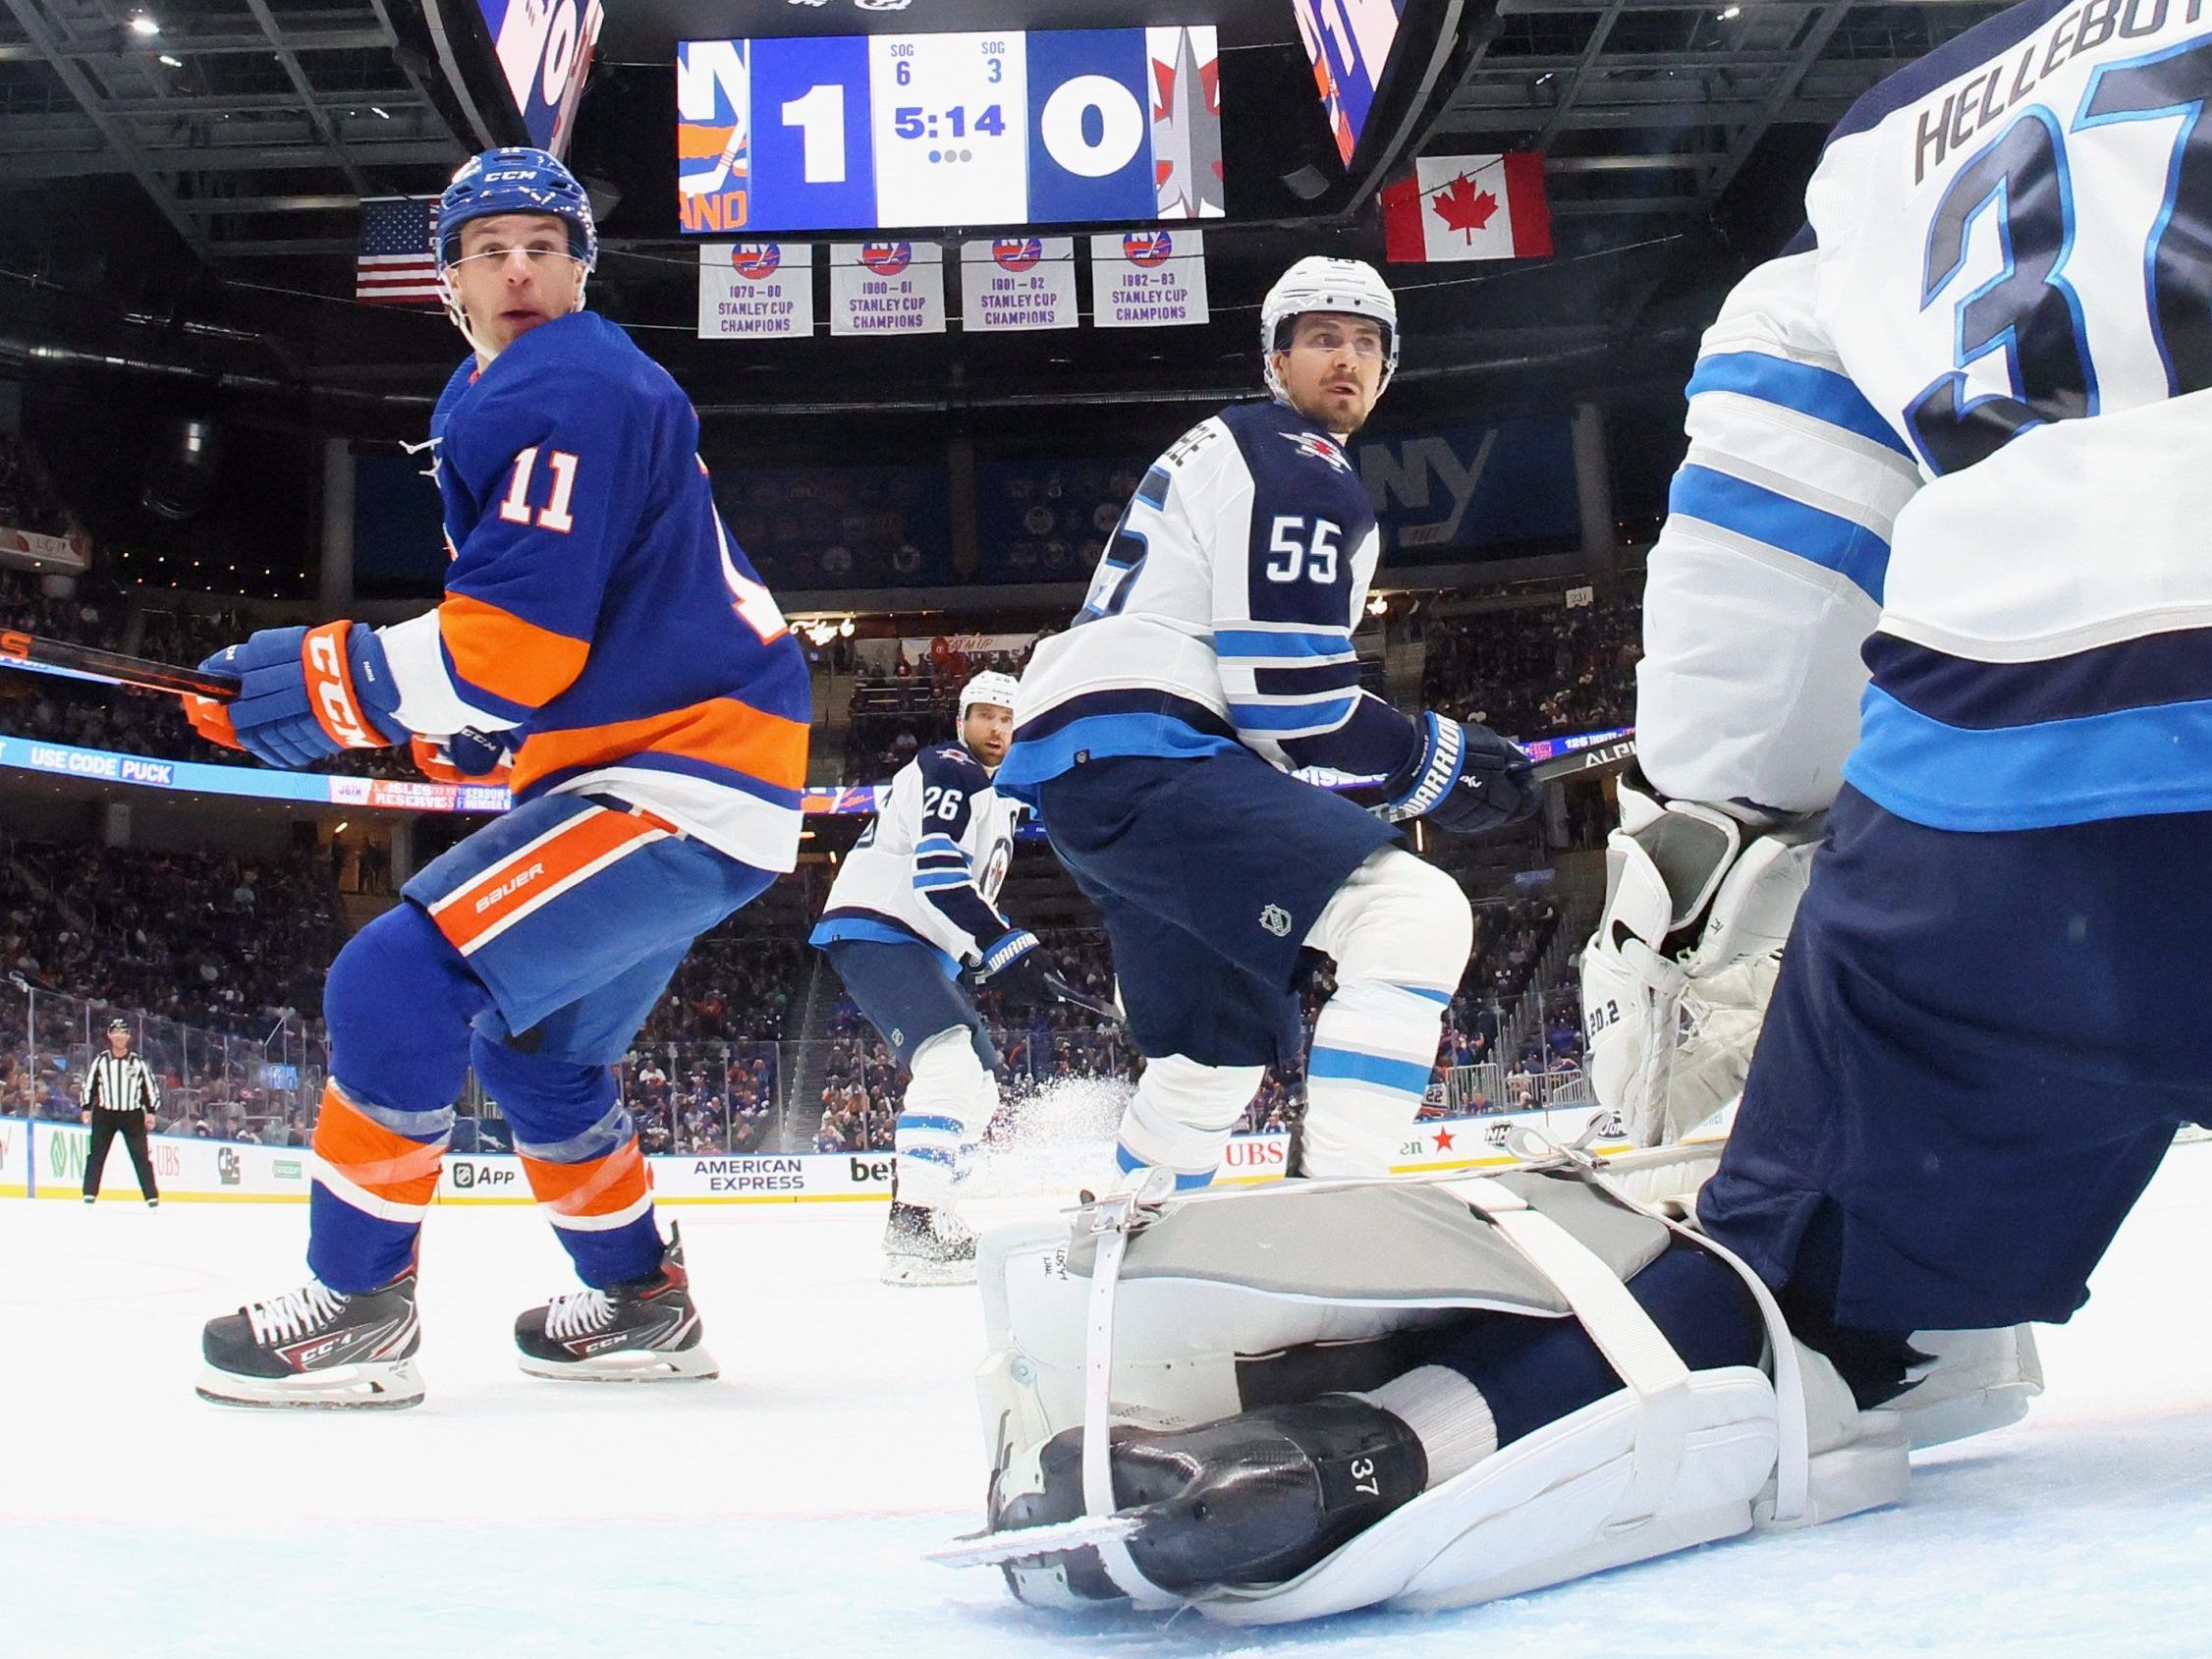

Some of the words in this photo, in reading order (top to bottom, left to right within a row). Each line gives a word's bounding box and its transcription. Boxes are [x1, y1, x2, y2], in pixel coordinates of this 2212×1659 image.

[891, 43, 914, 57] SOG
[981, 41, 1005, 55] SOG
[896, 60, 912, 86] 6
[987, 58, 1002, 83] 3
[781, 83, 847, 184] 1
[895, 104, 1006, 139] 5:14
[1041, 75, 1143, 177] 0
[484, 170, 538, 183] CCM
[1902, 33, 2212, 479] 37
[718, 302, 769, 315] STANLEY
[771, 302, 794, 314] CUP
[850, 299, 901, 311] STANLEY
[903, 297, 925, 310] CUP
[981, 294, 1032, 307] STANLEY
[1034, 293, 1058, 306] CUP
[1112, 290, 1163, 304] STANLEY
[1165, 289, 1188, 303] CUP
[721, 318, 791, 332] CHAMPIONS
[853, 314, 923, 329] CHAMPIONS
[984, 310, 1055, 325] CHAMPIONS
[1116, 306, 1187, 321] CHAMPIONS
[499, 446, 580, 534] 11
[1266, 515, 1343, 585] 55
[308, 634, 381, 748] CCM
[461, 728, 498, 752] CCM
[30, 747, 68, 769] USE
[69, 752, 119, 776] CODE
[121, 760, 172, 784] PUCK
[923, 787, 964, 821] 26
[475, 862, 545, 913] BAUER
[1426, 1089, 1443, 1103] 22
[156, 1144, 181, 1177] UBS
[1226, 1141, 1284, 1167] UBS
[693, 1159, 802, 1174] AMERICAN
[710, 1176, 804, 1190] EXPRESS
[585, 1334, 628, 1353] CCM
[1351, 1458, 1379, 1495] 37
